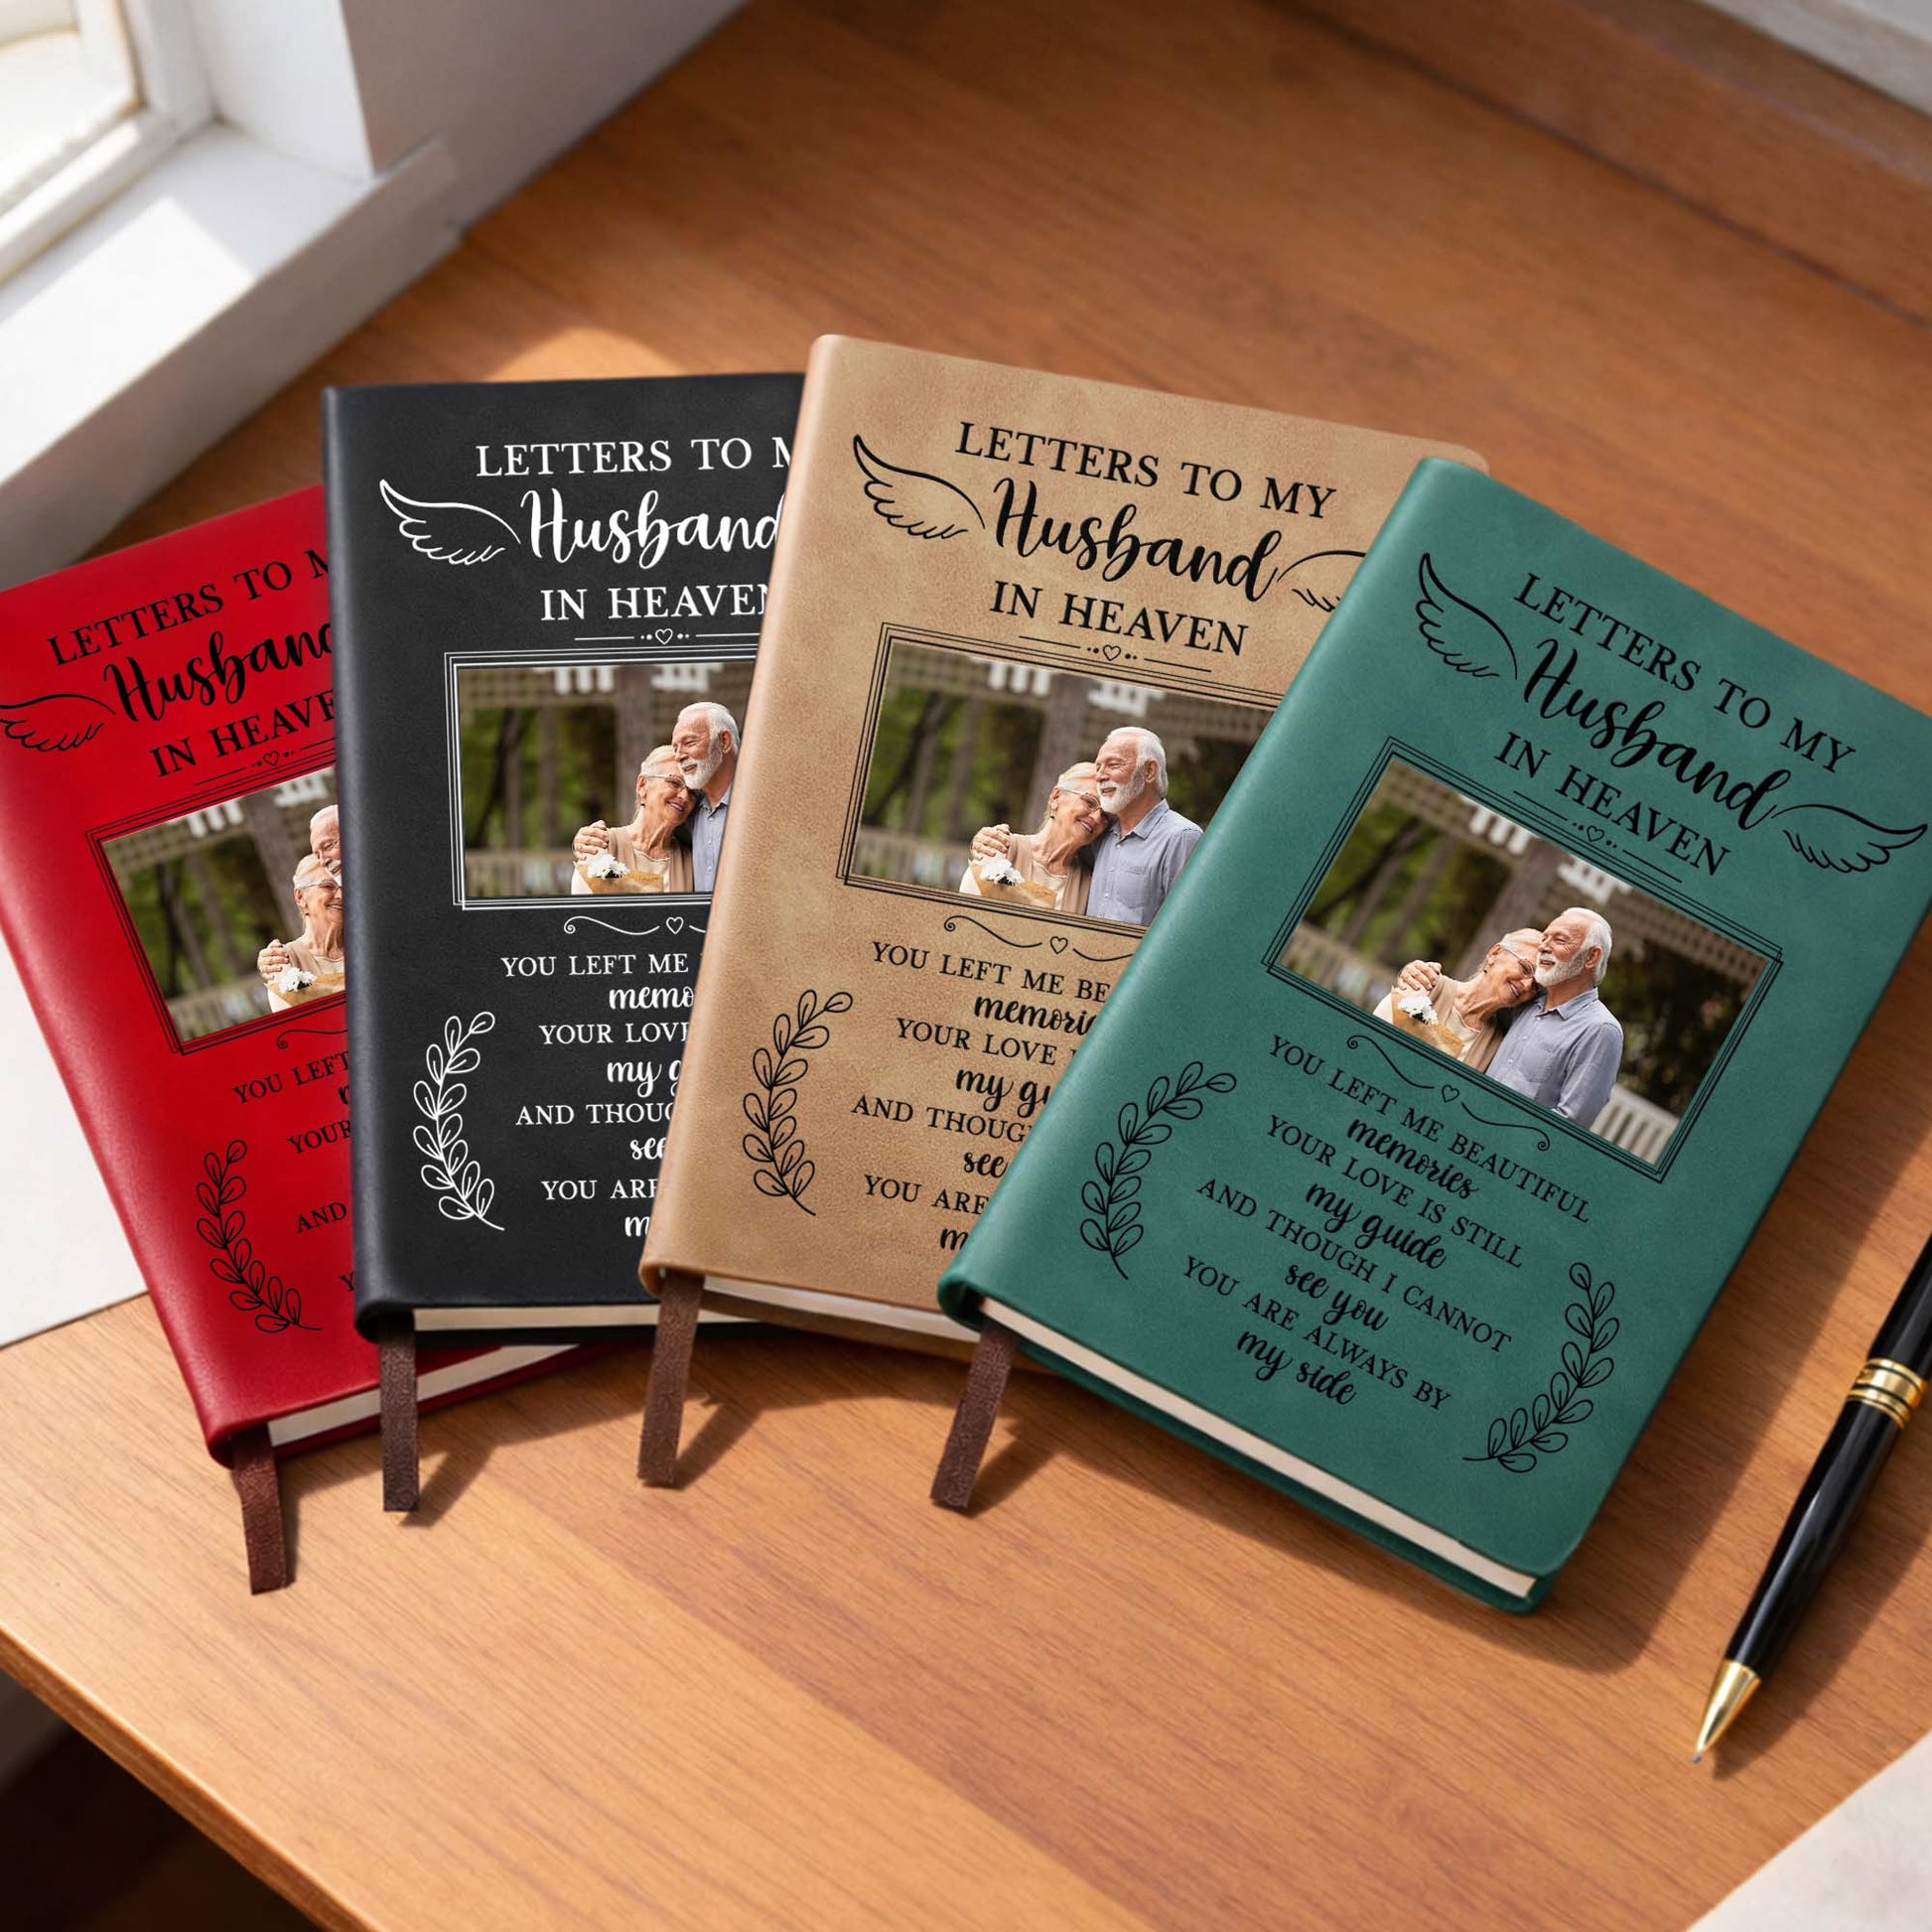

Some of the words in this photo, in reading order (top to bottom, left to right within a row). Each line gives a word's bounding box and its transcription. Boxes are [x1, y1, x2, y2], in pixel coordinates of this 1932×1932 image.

[476, 440, 672, 478] LETTERS
[691, 438, 753, 471] TO
[954, 421, 1161, 487] LETTERS
[1180, 462, 1242, 502] TO
[1259, 477, 1337, 518] MY
[993, 478, 1282, 603] Husband
[46, 583, 223, 666] LETTERS
[233, 561, 293, 601] TO
[540, 588, 588, 621] IN
[989, 580, 1042, 619] IN
[1058, 593, 1249, 656] HEAVEN
[1514, 573, 1702, 692] LETTERS
[1714, 678, 1772, 728] TO
[1780, 718, 1856, 773] MY
[150, 739, 198, 777] IN
[1523, 637, 1791, 831] Husband
[1494, 732, 1552, 778] IN
[1555, 764, 1731, 877] HEAVEN
[500, 956, 556, 977] YOU
[569, 954, 635, 976] LEFT
[648, 953, 688, 974] ME
[873, 941, 929, 969] YOU
[939, 953, 1012, 985] LEFT
[1021, 968, 1064, 996] ME
[539, 1024, 613, 1044] YOUR
[897, 1017, 970, 1050] YOUR
[983, 1034, 1057, 1065] LOVE
[232, 1073, 283, 1104] YOU
[607, 1060, 662, 1098] my
[955, 1069, 1015, 1112] my
[515, 1105, 575, 1126] AND
[851, 1094, 913, 1123] AND
[926, 1107, 1033, 1143] THOUG
[1269, 1035, 1325, 1076] YOU
[1328, 1068, 1397, 1116] LEFT
[1400, 1108, 1445, 1143] ME
[1448, 1133, 1589, 1224] BEAUTIFUL
[963, 1151, 1008, 1178] see
[1347, 1119, 1480, 1199] memories
[541, 1179, 598, 1199] YOU
[864, 1173, 921, 1202] YOU
[931, 1189, 989, 1215] ARE
[1266, 1115, 1337, 1168] YOUR
[1341, 1158, 1415, 1208] LOVE
[1418, 1197, 1447, 1224] IS
[1450, 1216, 1524, 1269] STILL
[297, 1201, 347, 1233] AND
[1306, 1182, 1362, 1234] my
[1354, 1214, 1448, 1269] guide
[1196, 1178, 1257, 1218] AND
[1266, 1209, 1378, 1284] THOUGH
[1382, 1273, 1398, 1295] I
[1403, 1285, 1512, 1353] CANNOT
[1285, 1264, 1329, 1300] see
[1322, 1290, 1389, 1331] you
[1182, 1256, 1239, 1297] YOU
[1242, 1292, 1300, 1331] ARE
[1303, 1324, 1409, 1389] ALWAYS
[1412, 1381, 1452, 1411] BY
[1237, 1330, 1294, 1382] my
[1296, 1361, 1356, 1406] side
